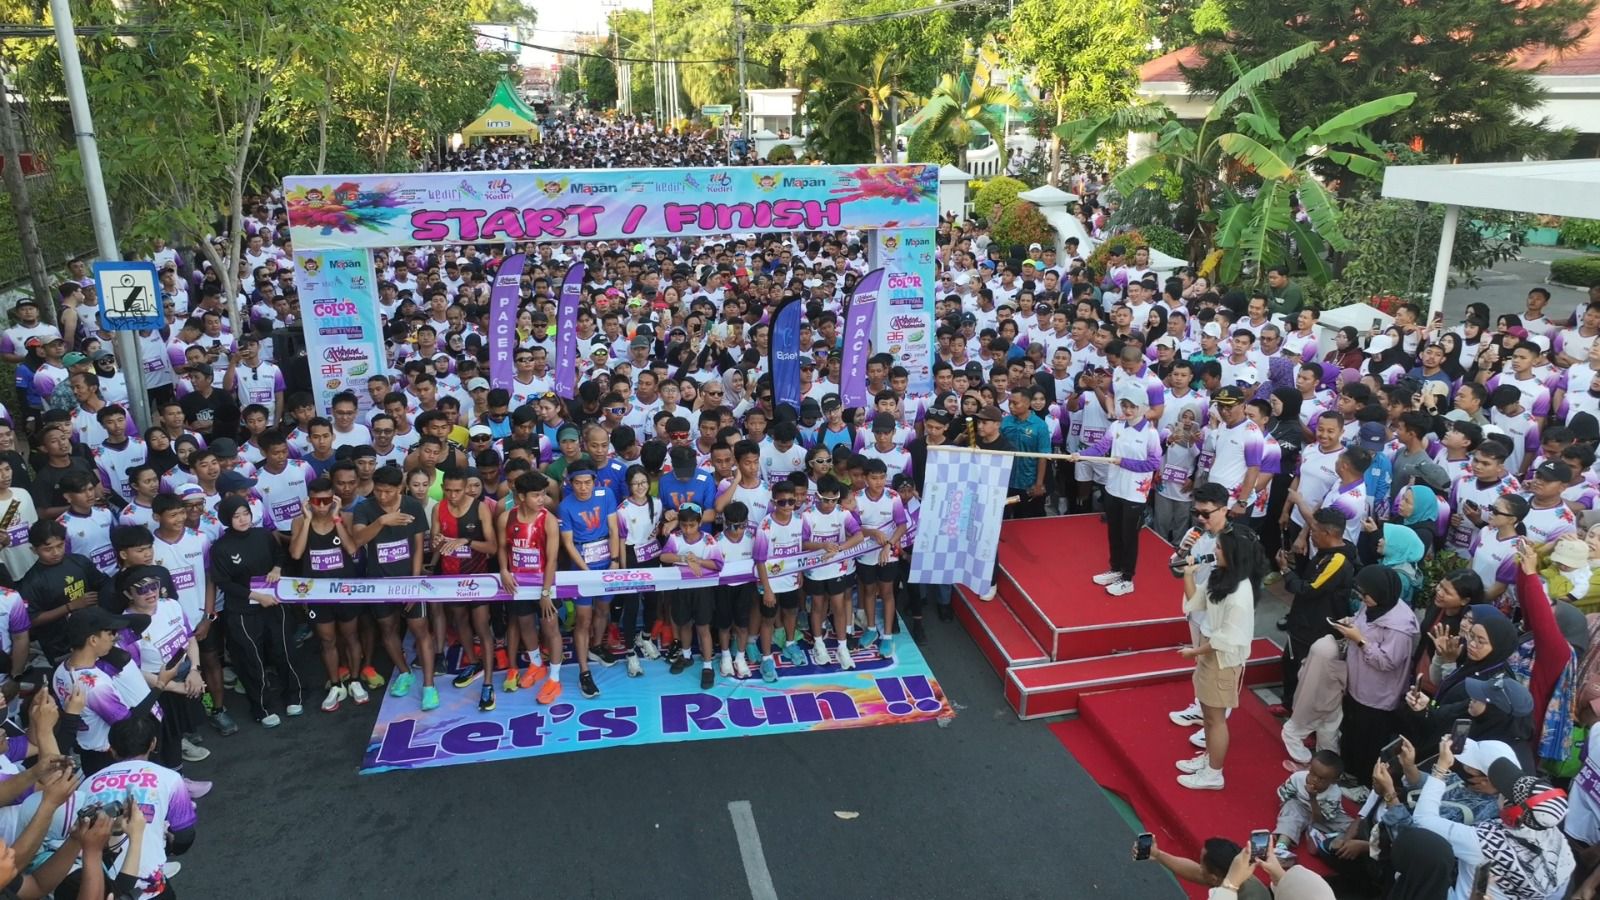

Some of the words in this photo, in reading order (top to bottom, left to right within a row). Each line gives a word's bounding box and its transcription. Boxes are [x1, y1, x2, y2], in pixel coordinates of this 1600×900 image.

[570, 183, 618, 195] Mapan
[783, 177, 826, 189] Mapan
[411, 204, 606, 242] START
[622, 204, 647, 235] /
[664, 199, 841, 233] FINISH
[905, 238, 930, 248] Mapan
[329, 259, 361, 271] Mapan
[497, 297, 509, 361] PACER
[579, 506, 602, 531] W
[378, 548, 389, 557] AG
[636, 548, 646, 557] AG
[774, 547, 784, 556] AG
[311, 556, 321, 565] AG
[329, 582, 376, 596] Mapan
[160, 645, 172, 657] AG
[374, 702, 640, 763] Let's
[660, 690, 863, 734] Run
